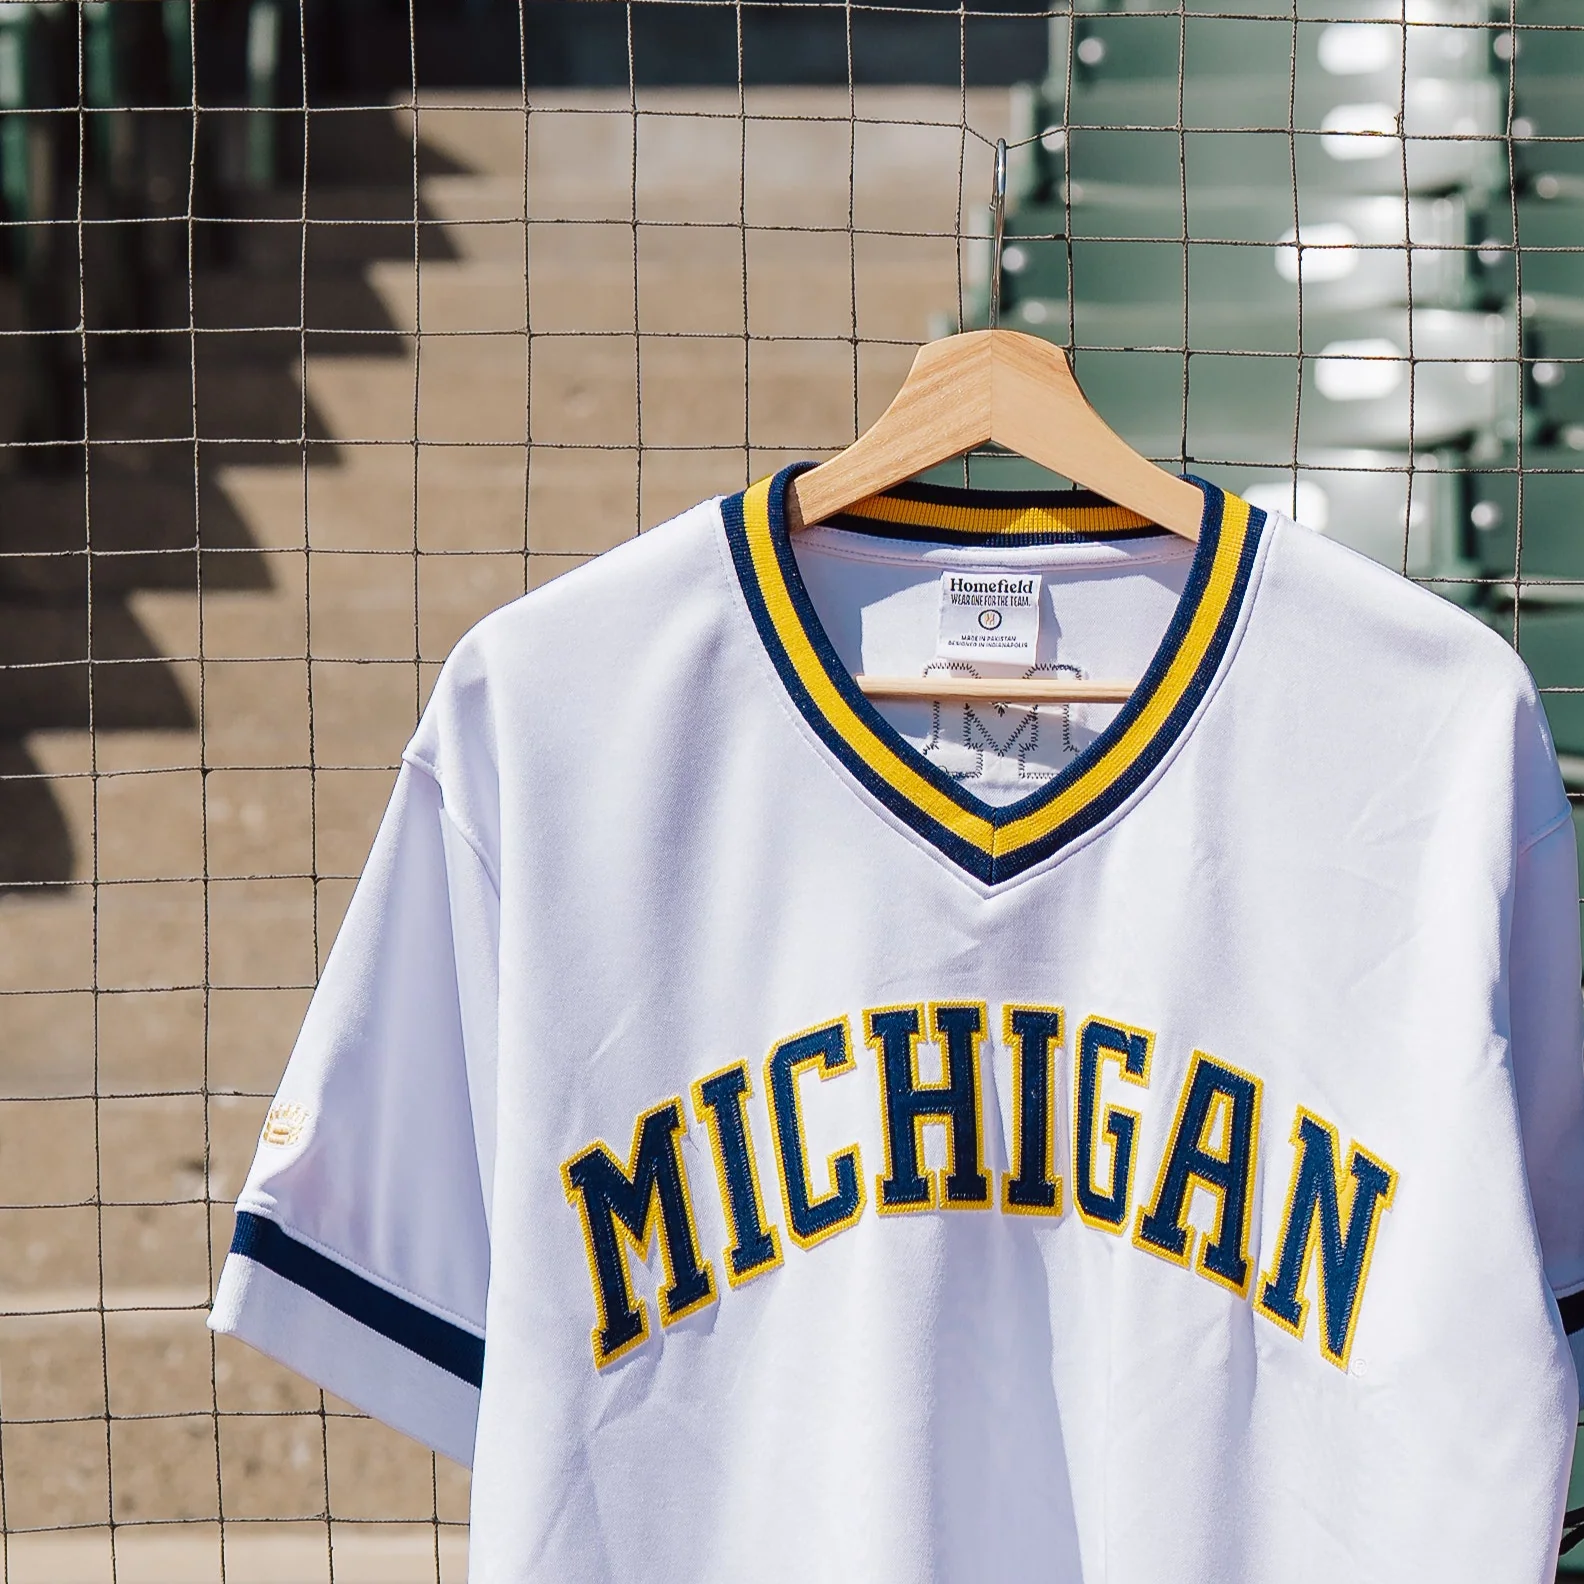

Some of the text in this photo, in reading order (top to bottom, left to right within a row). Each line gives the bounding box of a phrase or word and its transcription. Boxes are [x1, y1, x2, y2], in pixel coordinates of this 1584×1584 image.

[950, 578, 1033, 594] Homefield
[951, 594, 1031, 607] WEAR ONE FOR THE TEAM.
[559, 999, 1399, 1372] MICHIGAN
